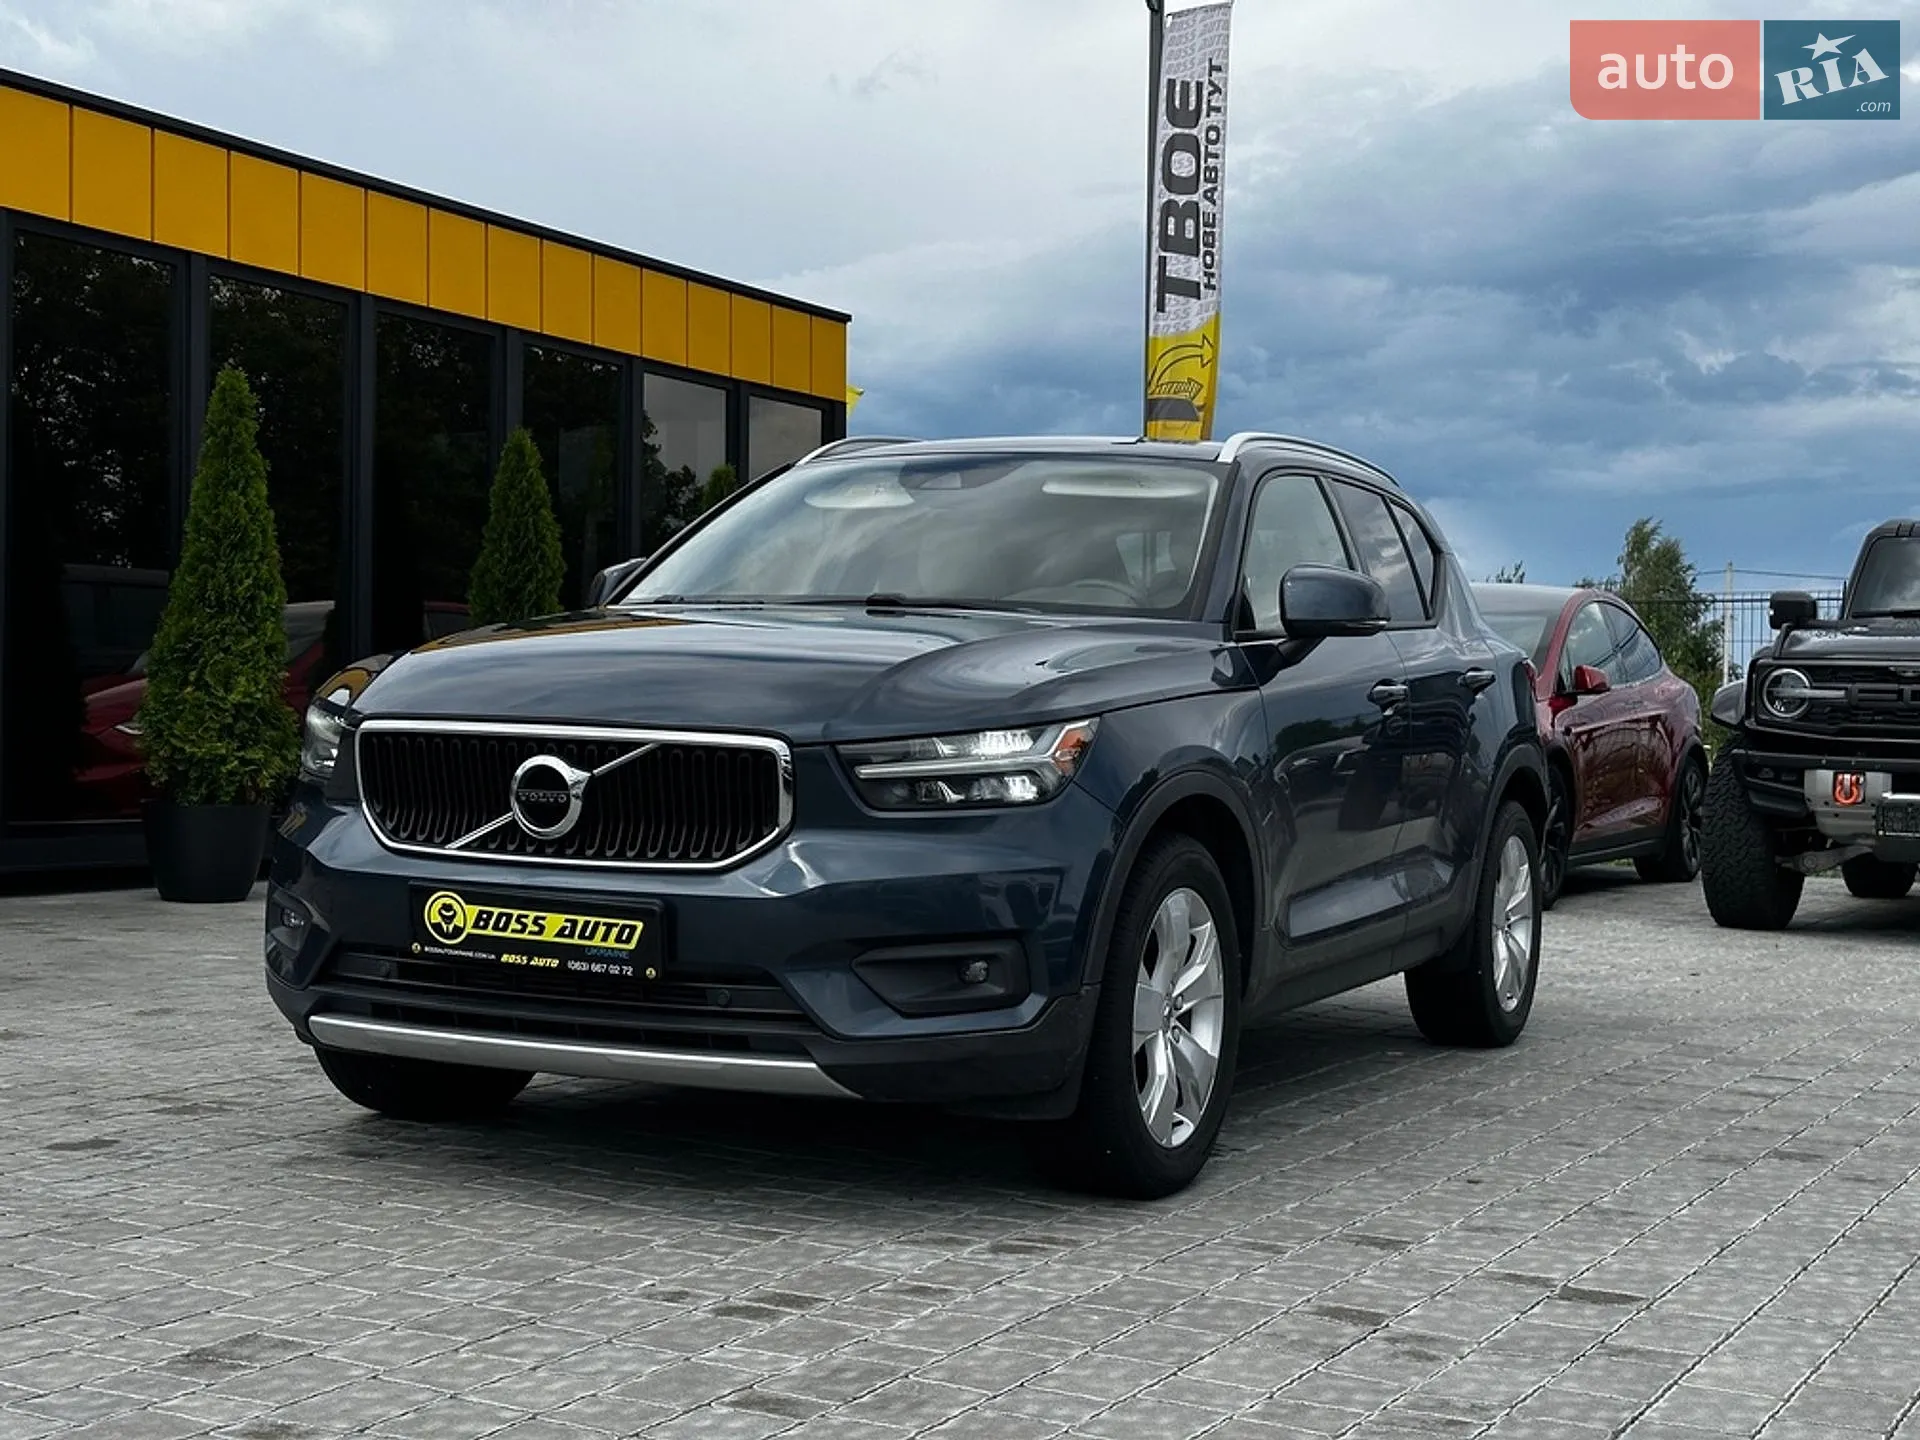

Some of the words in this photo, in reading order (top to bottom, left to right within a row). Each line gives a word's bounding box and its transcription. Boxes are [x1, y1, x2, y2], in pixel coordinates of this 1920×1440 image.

[1206, 58, 1224, 119] ТУТ
[1202, 125, 1221, 205] АВТО
[1157, 78, 1203, 313] ТВОЄ
[1203, 209, 1217, 291] НОВЕ
[518, 792, 567, 802] VOLVO
[472, 909, 547, 936] BOSS
[553, 918, 638, 944] AUTO
[500, 953, 527, 965] BOSS
[529, 956, 559, 968] AUTO
[621, 966, 634, 977] 72
